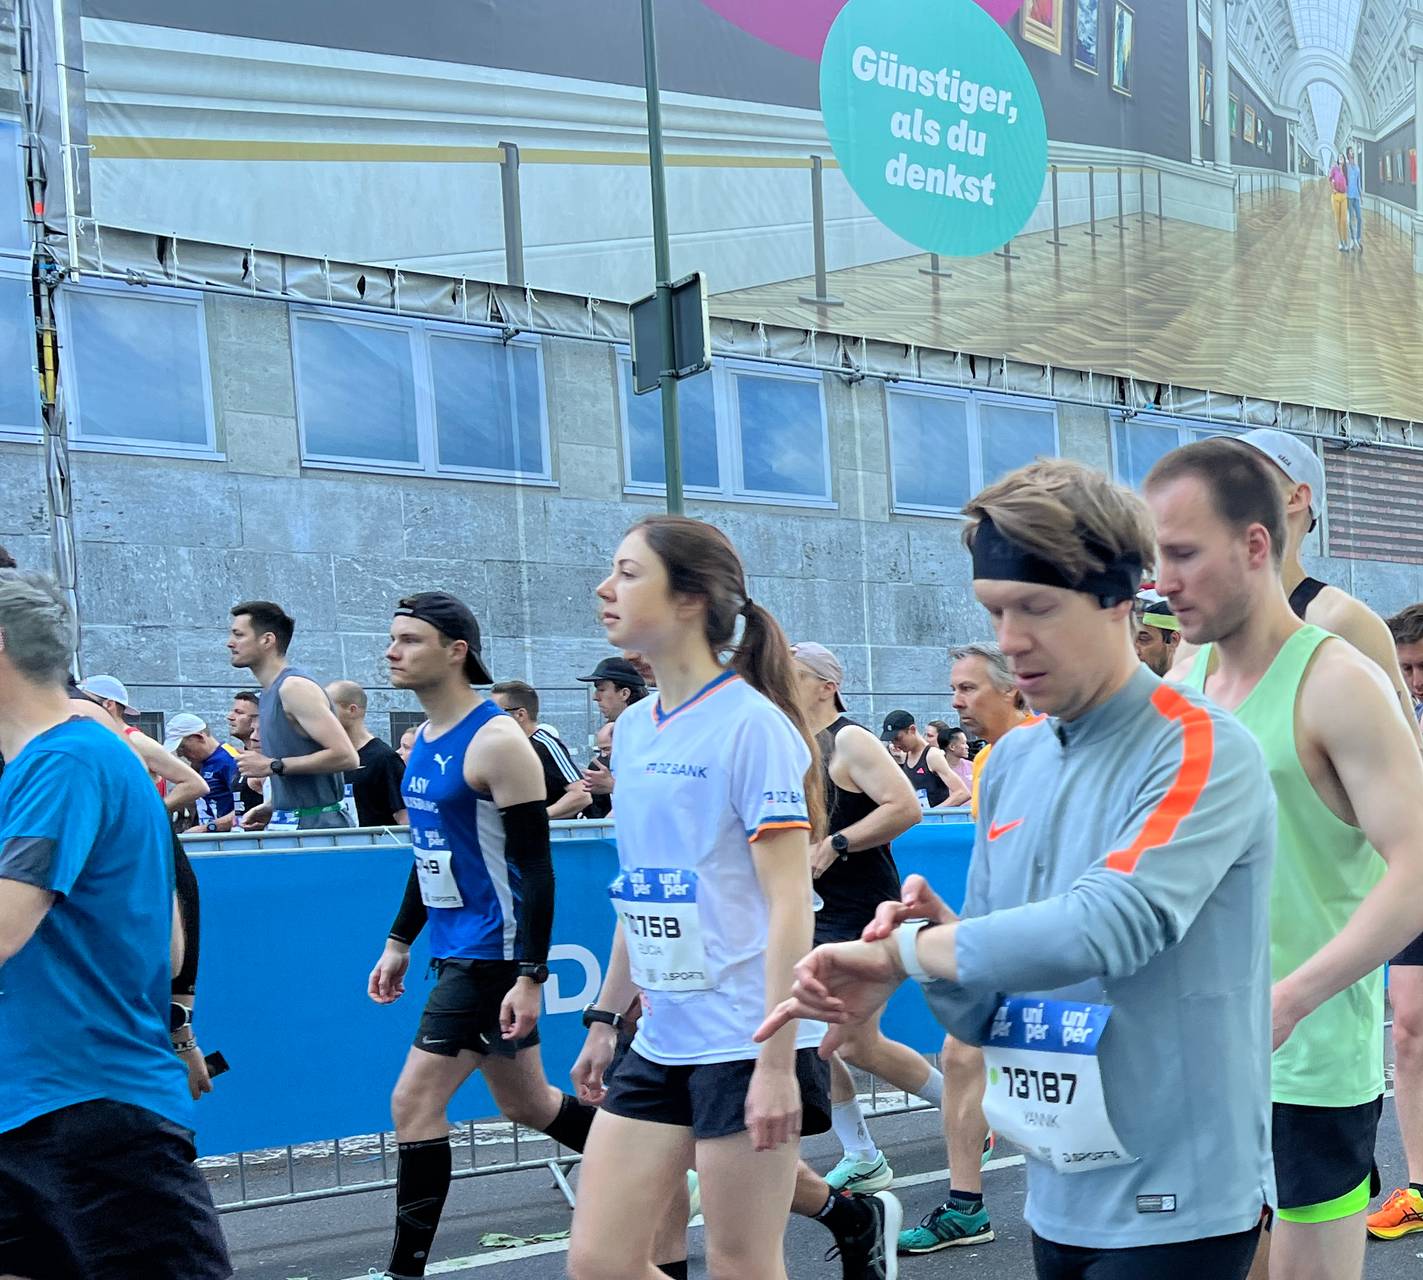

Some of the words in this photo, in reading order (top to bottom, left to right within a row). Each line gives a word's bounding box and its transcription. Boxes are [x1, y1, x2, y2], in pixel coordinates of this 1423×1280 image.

[852, 45, 1018, 124] Günstiger,
[890, 108, 941, 146] als
[947, 120, 987, 156] du
[885, 153, 996, 206] denkst
[408, 776, 430, 794] ASV
[658, 869, 682, 884] uni
[663, 883, 690, 899] per
[1022, 1002, 1044, 1024] uni
[1061, 1006, 1092, 1028] uni
[1025, 1023, 1049, 1044] per
[1062, 1026, 1094, 1047] per
[1002, 1066, 1077, 1105] 13187
